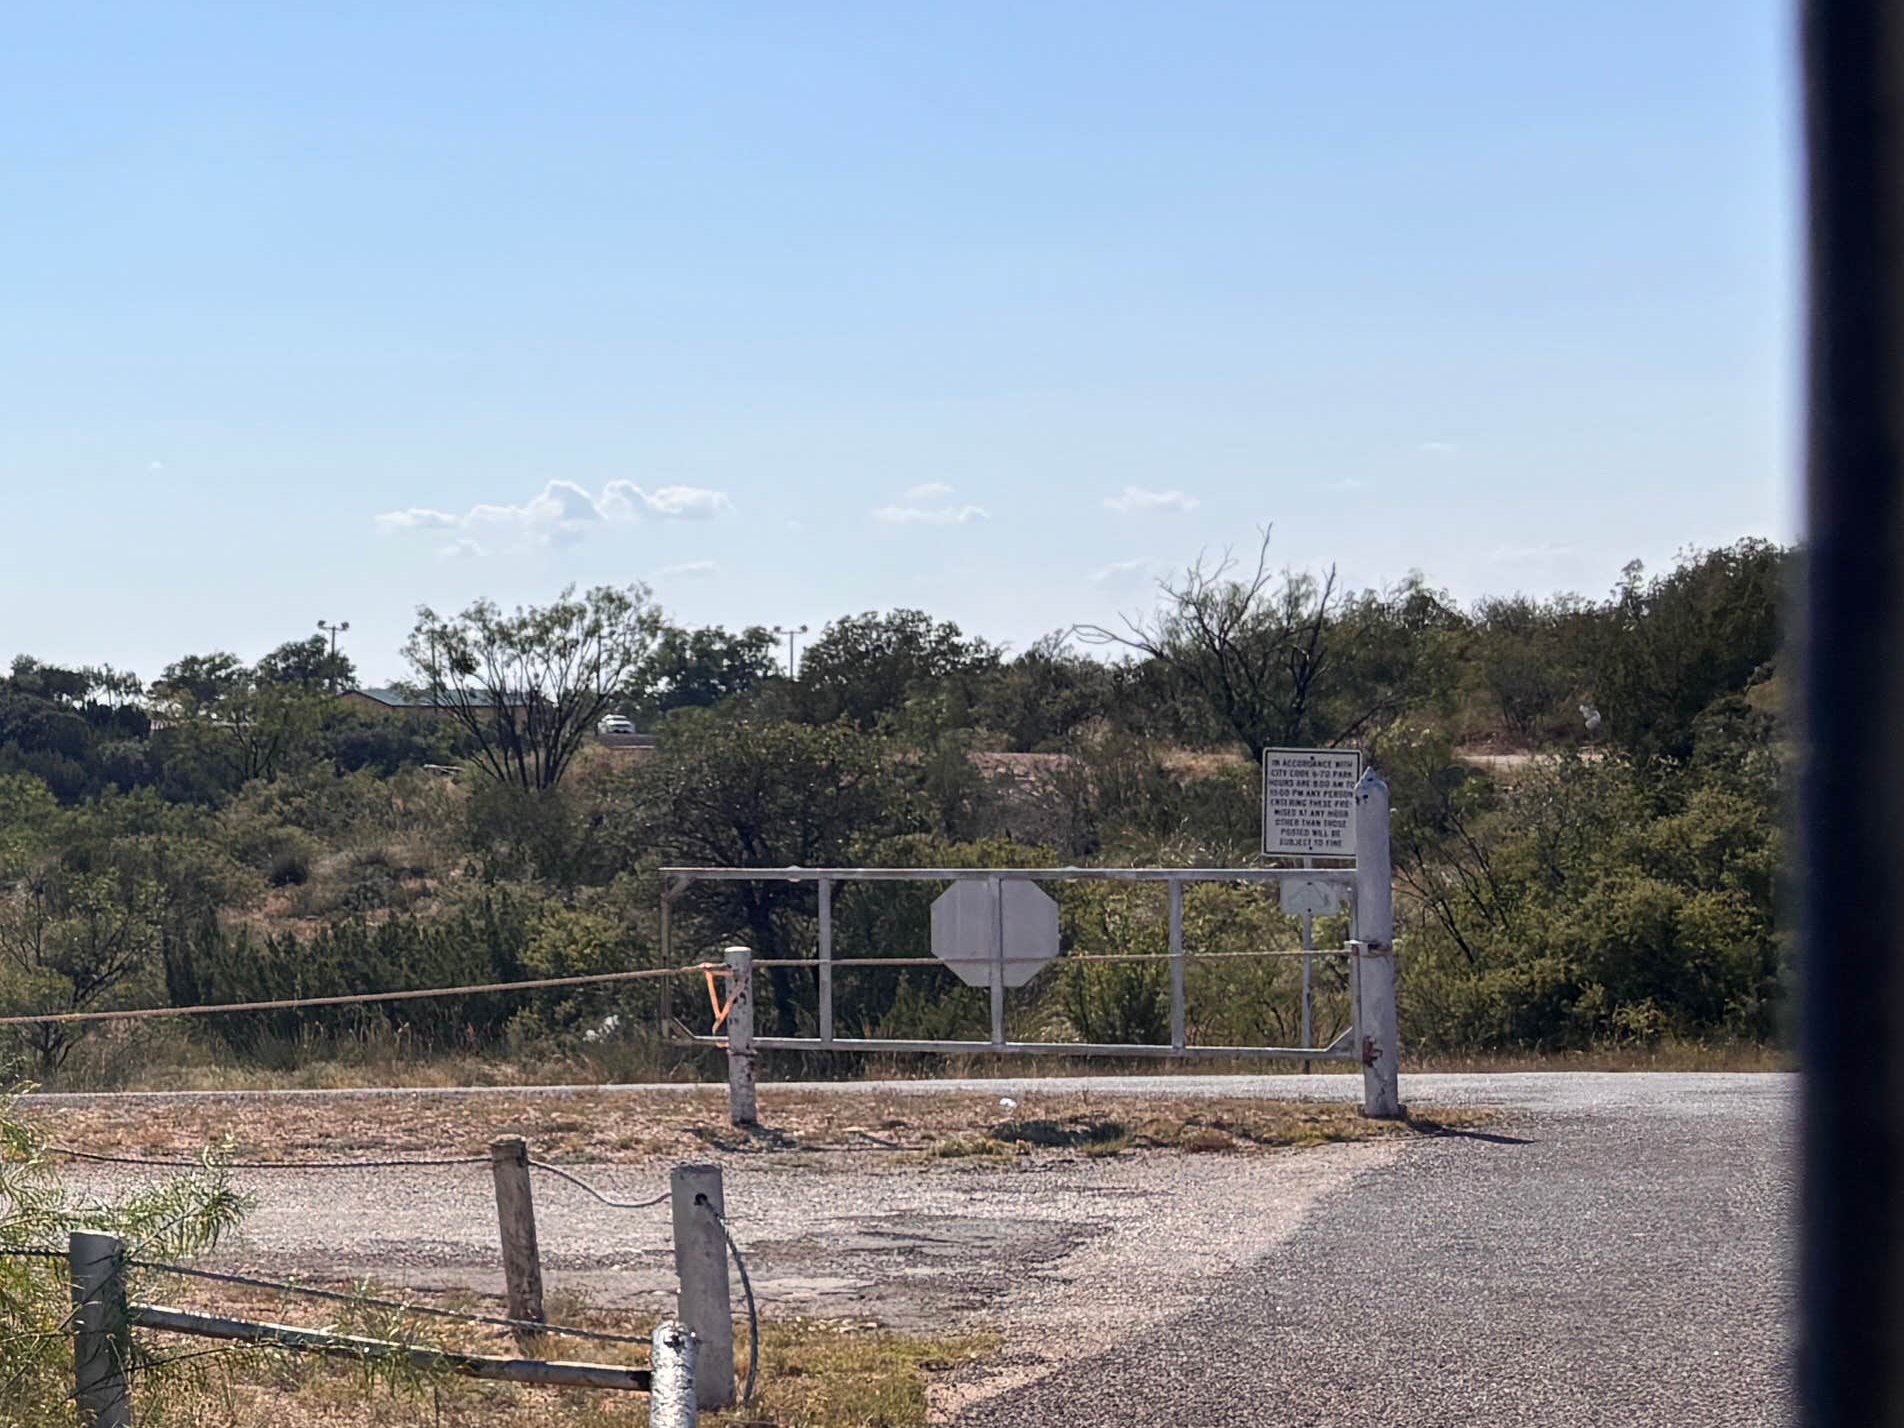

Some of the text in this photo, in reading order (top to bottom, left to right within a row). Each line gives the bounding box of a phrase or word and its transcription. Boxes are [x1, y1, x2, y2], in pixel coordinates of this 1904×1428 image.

[1283, 759, 1332, 768] ACCORDANCE
[1336, 760, 1352, 768] WITH
[1271, 768, 1287, 777] CITY
[1290, 768, 1309, 777] CODE
[1333, 770, 1352, 778] PARK
[1269, 779, 1292, 787] HOURS
[1296, 780, 1309, 788] ARE
[1346, 781, 1355, 789] TO
[1292, 790, 1303, 798] PM
[1306, 790, 1320, 798] ANY
[1323, 790, 1353, 799] PERSON
[1271, 799, 1306, 808] ENTERING
[1310, 799, 1330, 808] THESE
[1299, 809, 1307, 817] AT
[1310, 810, 1324, 818] ANY
[1328, 810, 1348, 818] HOUR
[1275, 819, 1299, 827] OTHER
[1324, 820, 1346, 828] THOSE
[1281, 828, 1340, 837] POSTED WILL BE
[1280, 838, 1342, 847] SUBJECT TO FINE
